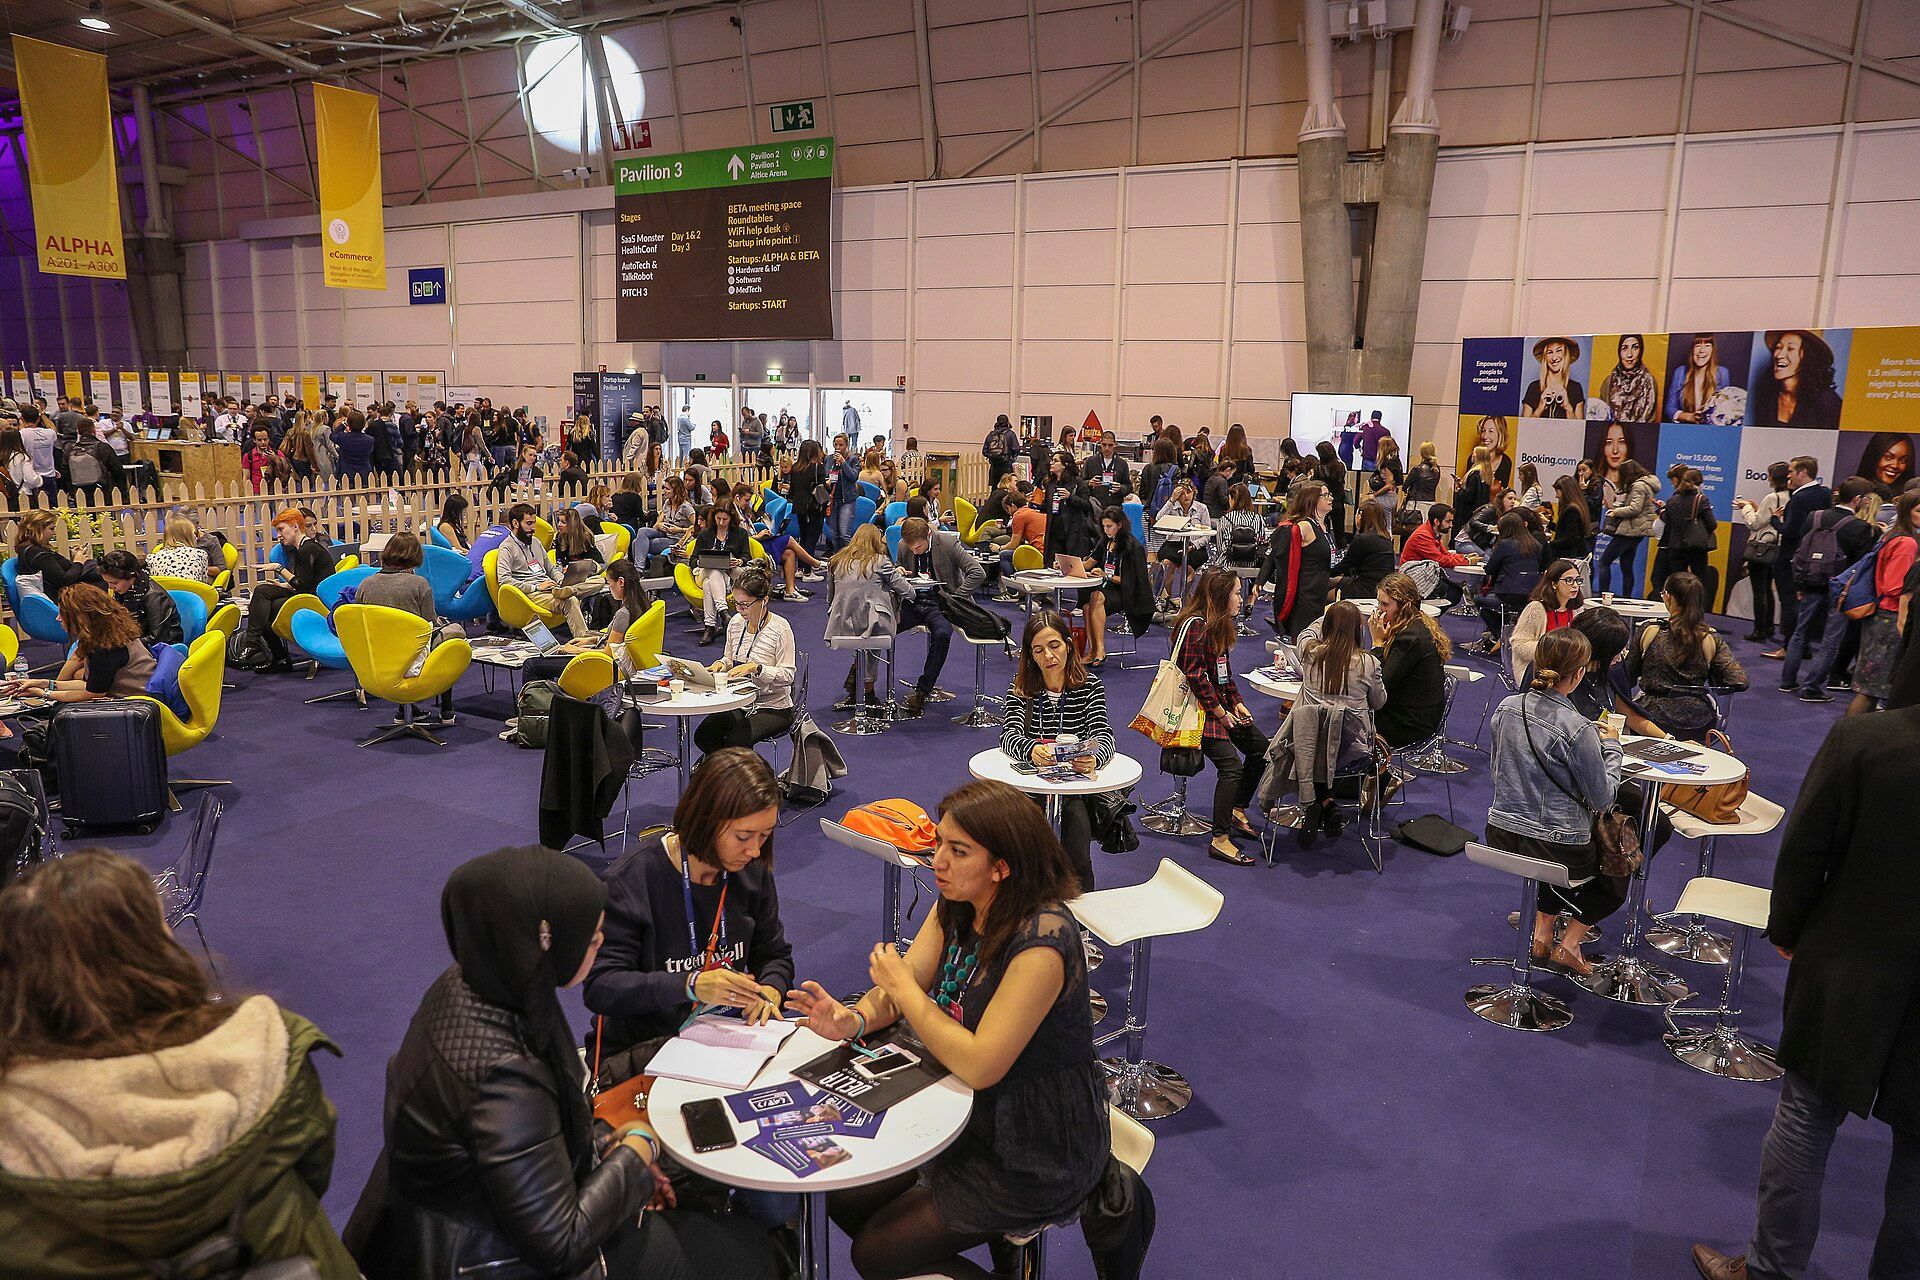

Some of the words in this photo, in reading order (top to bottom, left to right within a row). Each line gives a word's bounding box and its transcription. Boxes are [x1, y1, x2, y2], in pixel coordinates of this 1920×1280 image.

[751, 152, 774, 161] Pavilion
[751, 162, 774, 170] Pavilion
[620, 164, 670, 183] Pavilion
[674, 162, 682, 178] 3
[751, 171, 768, 179] Altice
[769, 169, 787, 177] Arena
[728, 204, 748, 213] BETA
[749, 202, 780, 212] meeting
[780, 201, 802, 210] space
[621, 214, 641, 223] Stages
[728, 214, 773, 225] Roundtables
[728, 226, 745, 236] WiFi
[747, 226, 762, 236] help
[764, 224, 781, 233] desk
[621, 235, 636, 244] SaaS
[636, 233, 665, 242] Monster
[671, 232, 684, 241] Day
[46, 236, 114, 256] ALPHA
[728, 239, 754, 248] Startup
[756, 237, 771, 246] info
[772, 236, 792, 246] point
[621, 244, 658, 255] HealthConf
[671, 243, 684, 253] Day
[685, 243, 691, 251] 3
[330, 251, 372, 261] eCommerce
[728, 255, 761, 264] Startups:
[762, 252, 789, 262] ALPHA
[790, 252, 797, 260] &
[798, 250, 820, 260] BETA
[621, 261, 650, 271] AutoTech
[652, 260, 658, 269] &
[735, 266, 764, 274] Hardware
[771, 264, 781, 272] IoT
[621, 272, 654, 281] TalkRobot
[735, 276, 762, 284] Software
[622, 288, 642, 297] PITCH
[643, 288, 648, 296] 3
[736, 285, 762, 294] MedTech
[728, 301, 761, 311] Startups:
[762, 300, 787, 309] START
[1869, 380, 1896, 389] nights
[1866, 392, 1891, 400] every
[1522, 453, 1576, 466] Booking.com
[819, 1071, 873, 1098] DELTA
